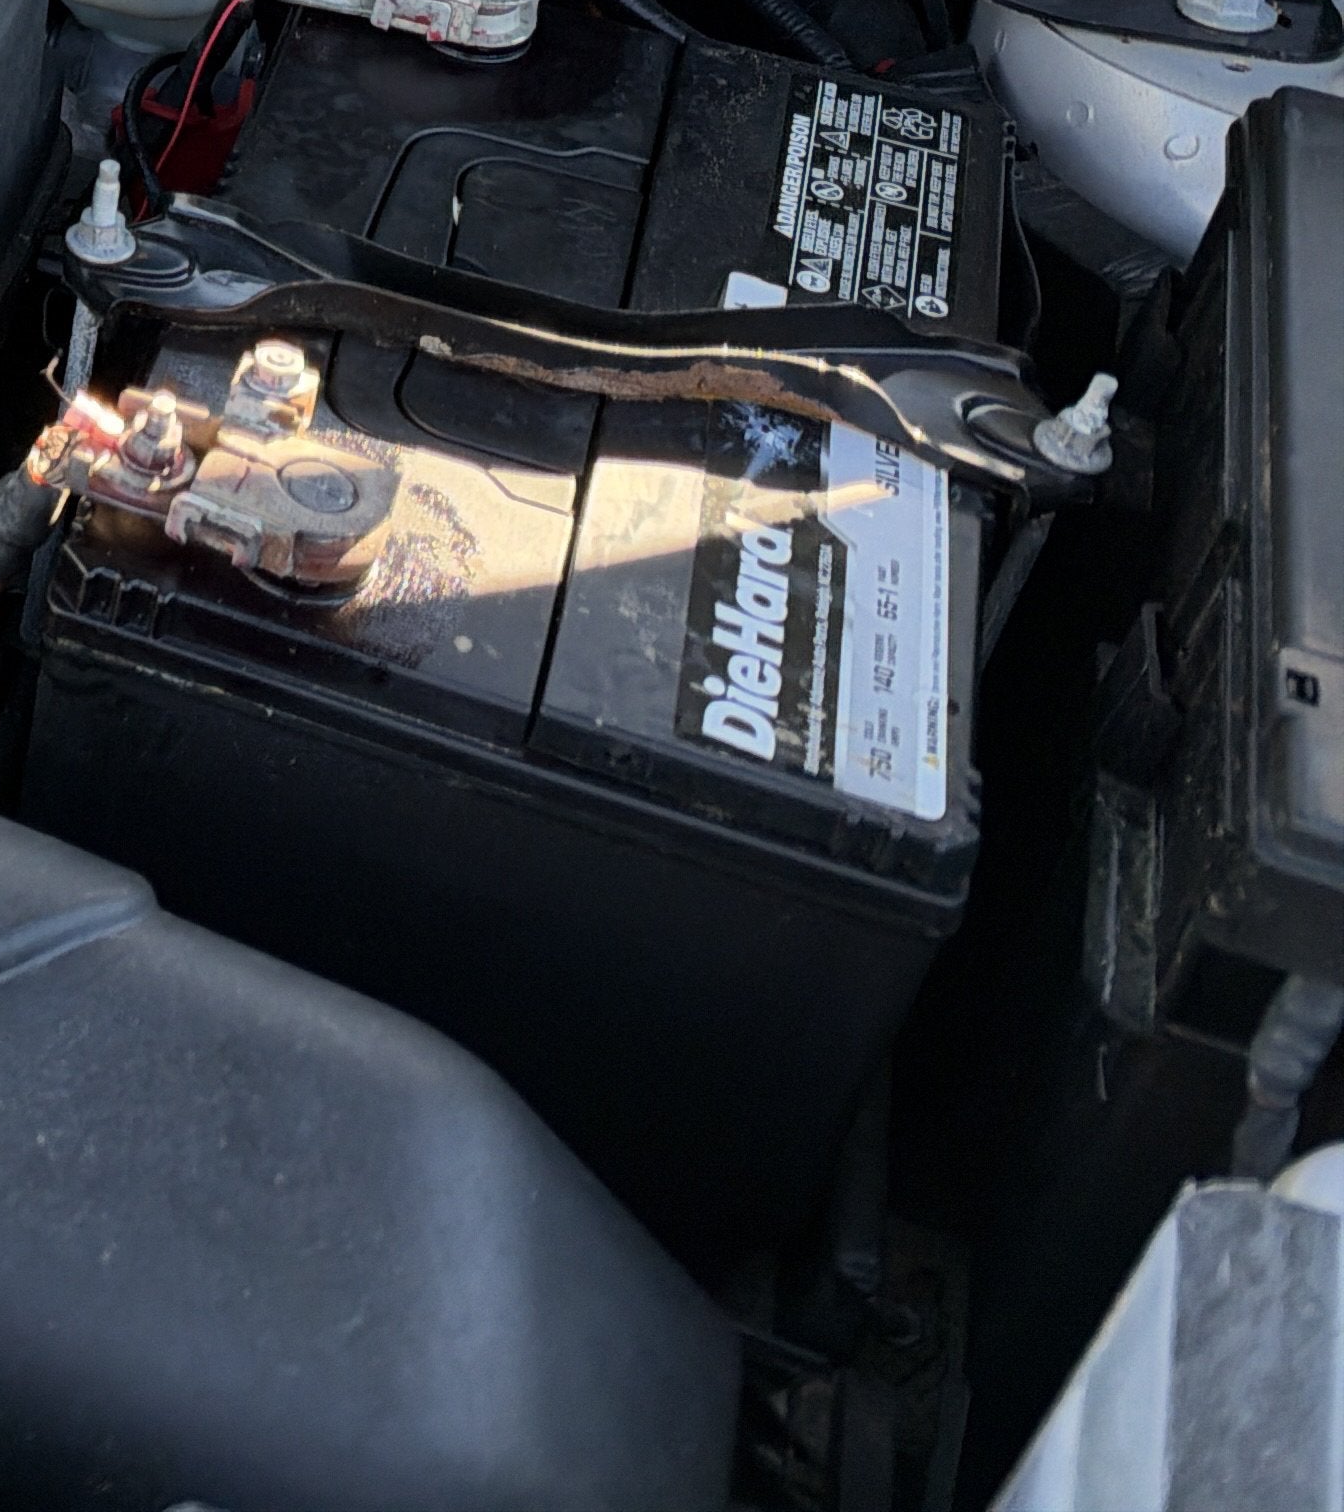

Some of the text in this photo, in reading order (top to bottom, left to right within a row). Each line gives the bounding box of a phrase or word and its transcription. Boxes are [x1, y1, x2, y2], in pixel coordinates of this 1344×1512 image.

[776, 113, 811, 225] DANGER/POISON
[875, 440, 900, 497] SILVE
[701, 510, 793, 762] DieHard
[873, 665, 895, 696] 140
